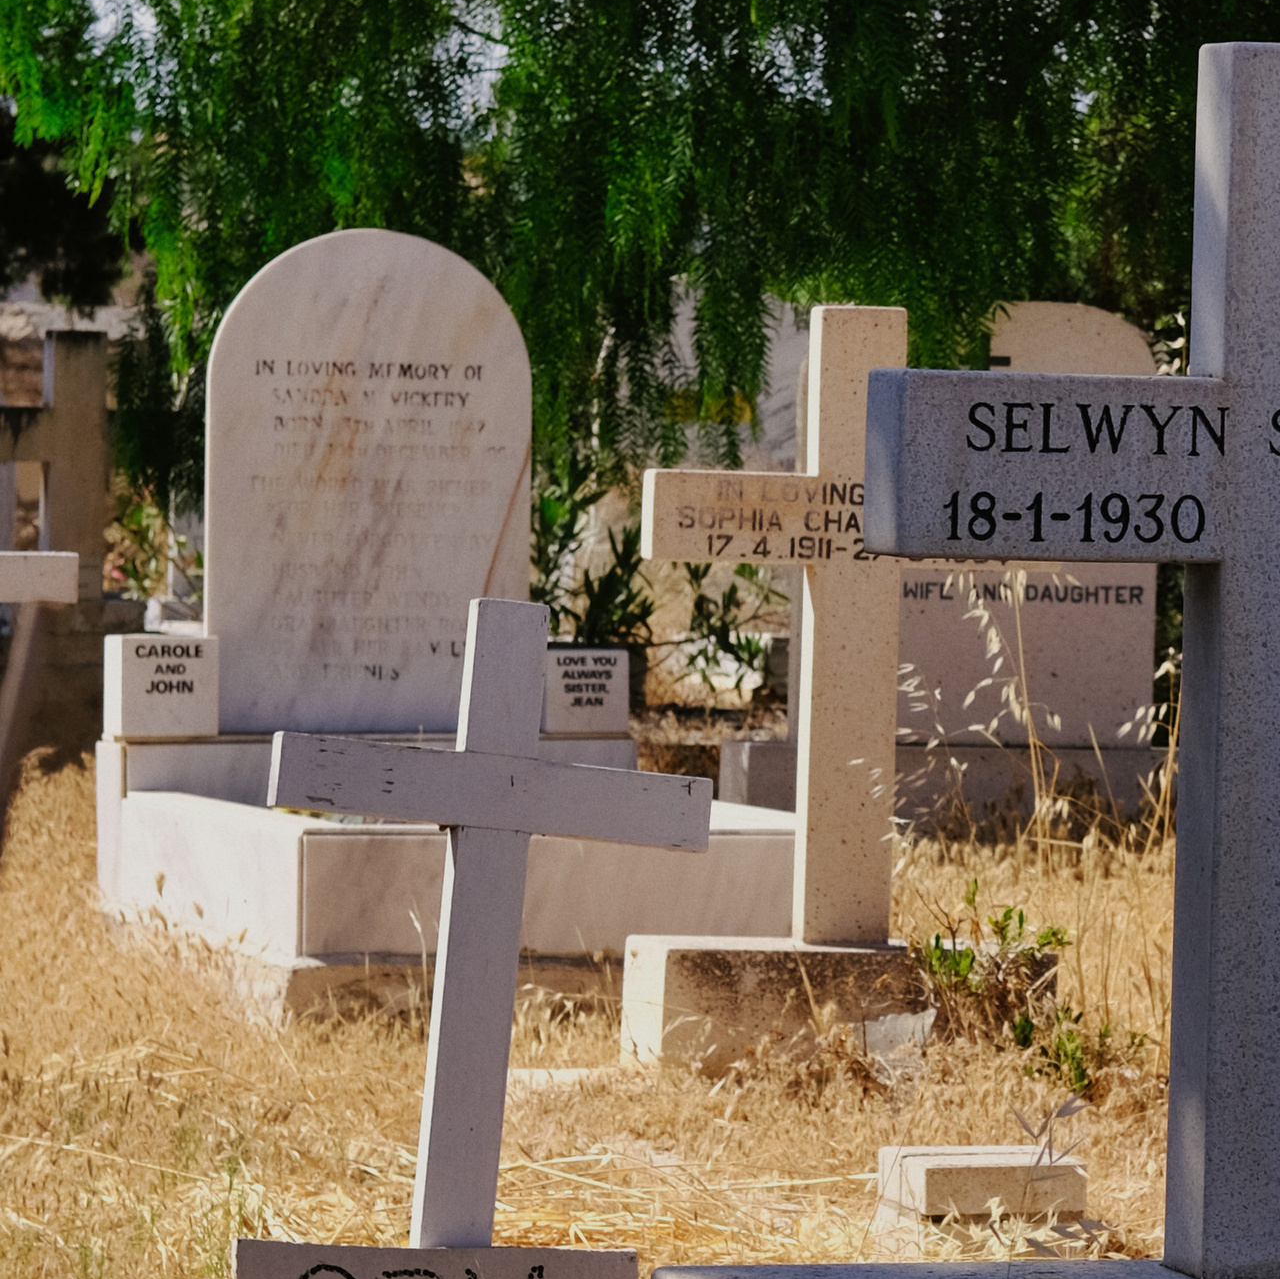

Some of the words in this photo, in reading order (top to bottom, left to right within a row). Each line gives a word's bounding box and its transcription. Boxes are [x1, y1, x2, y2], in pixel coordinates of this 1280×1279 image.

[255, 359, 275, 376] IN
[286, 360, 357, 377] LOVING
[368, 362, 452, 380] MEMORY
[966, 402, 1228, 457] SELWYN
[716, 479, 743, 503] IN
[761, 480, 865, 507] LOVING
[678, 505, 783, 531] SOPHIA
[803, 509, 863, 534] CHA
[942, 489, 1206, 545] 18-1-1930
[1025, 584, 1144, 605] DAUGHTER
[135, 645, 204, 658] CAROLE
[154, 664, 187, 675] AND
[556, 655, 587, 667] LOVE
[592, 656, 618, 667] YOU
[561, 669, 613, 681] ALWAYS
[145, 681, 194, 694] JOHN
[570, 696, 604, 707] JEAN
